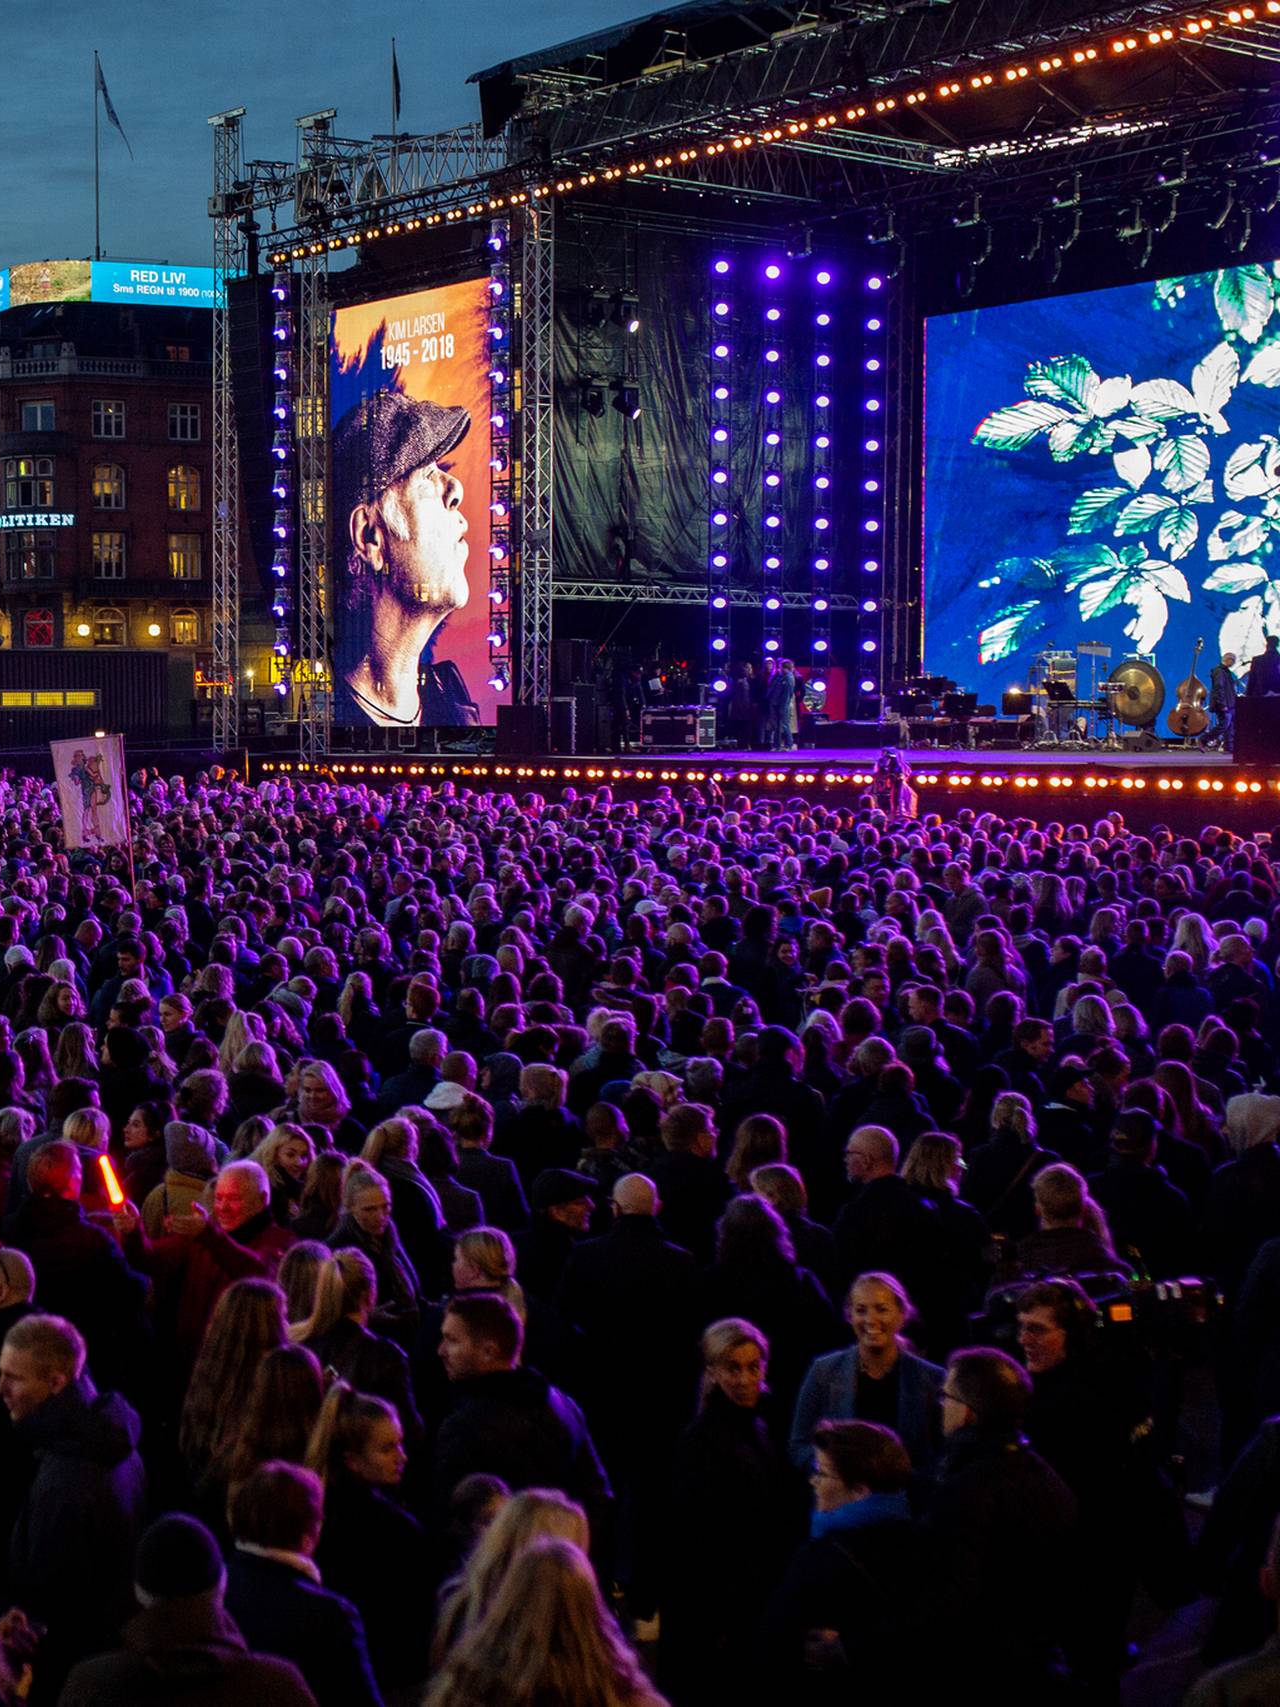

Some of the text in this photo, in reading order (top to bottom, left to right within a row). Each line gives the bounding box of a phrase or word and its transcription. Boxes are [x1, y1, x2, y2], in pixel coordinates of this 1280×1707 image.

[130, 270, 186, 284] RED LIV!
[113, 283, 134, 294] Sms
[136, 285, 164, 295] REGN
[166, 287, 175, 296] til
[178, 287, 200, 297] 1900
[388, 312, 445, 341] KIM LARSEN
[380, 341, 410, 370] 1945
[421, 333, 455, 363] 2018
